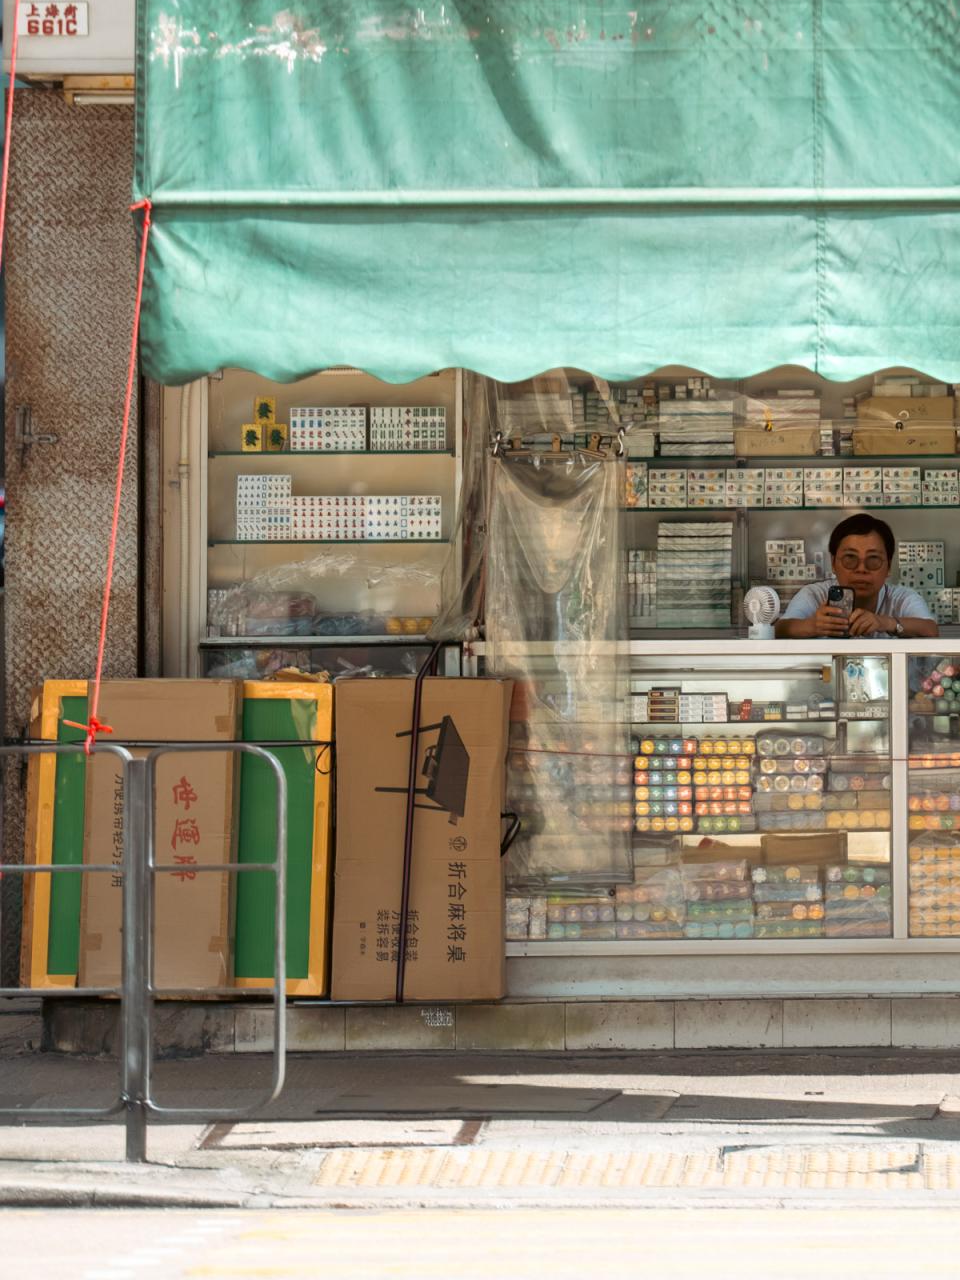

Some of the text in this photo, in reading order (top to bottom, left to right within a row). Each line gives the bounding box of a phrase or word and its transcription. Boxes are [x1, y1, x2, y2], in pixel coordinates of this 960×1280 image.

[27, 19, 78, 36] 661C
[447, 861, 467, 963] 折合麻将桌
